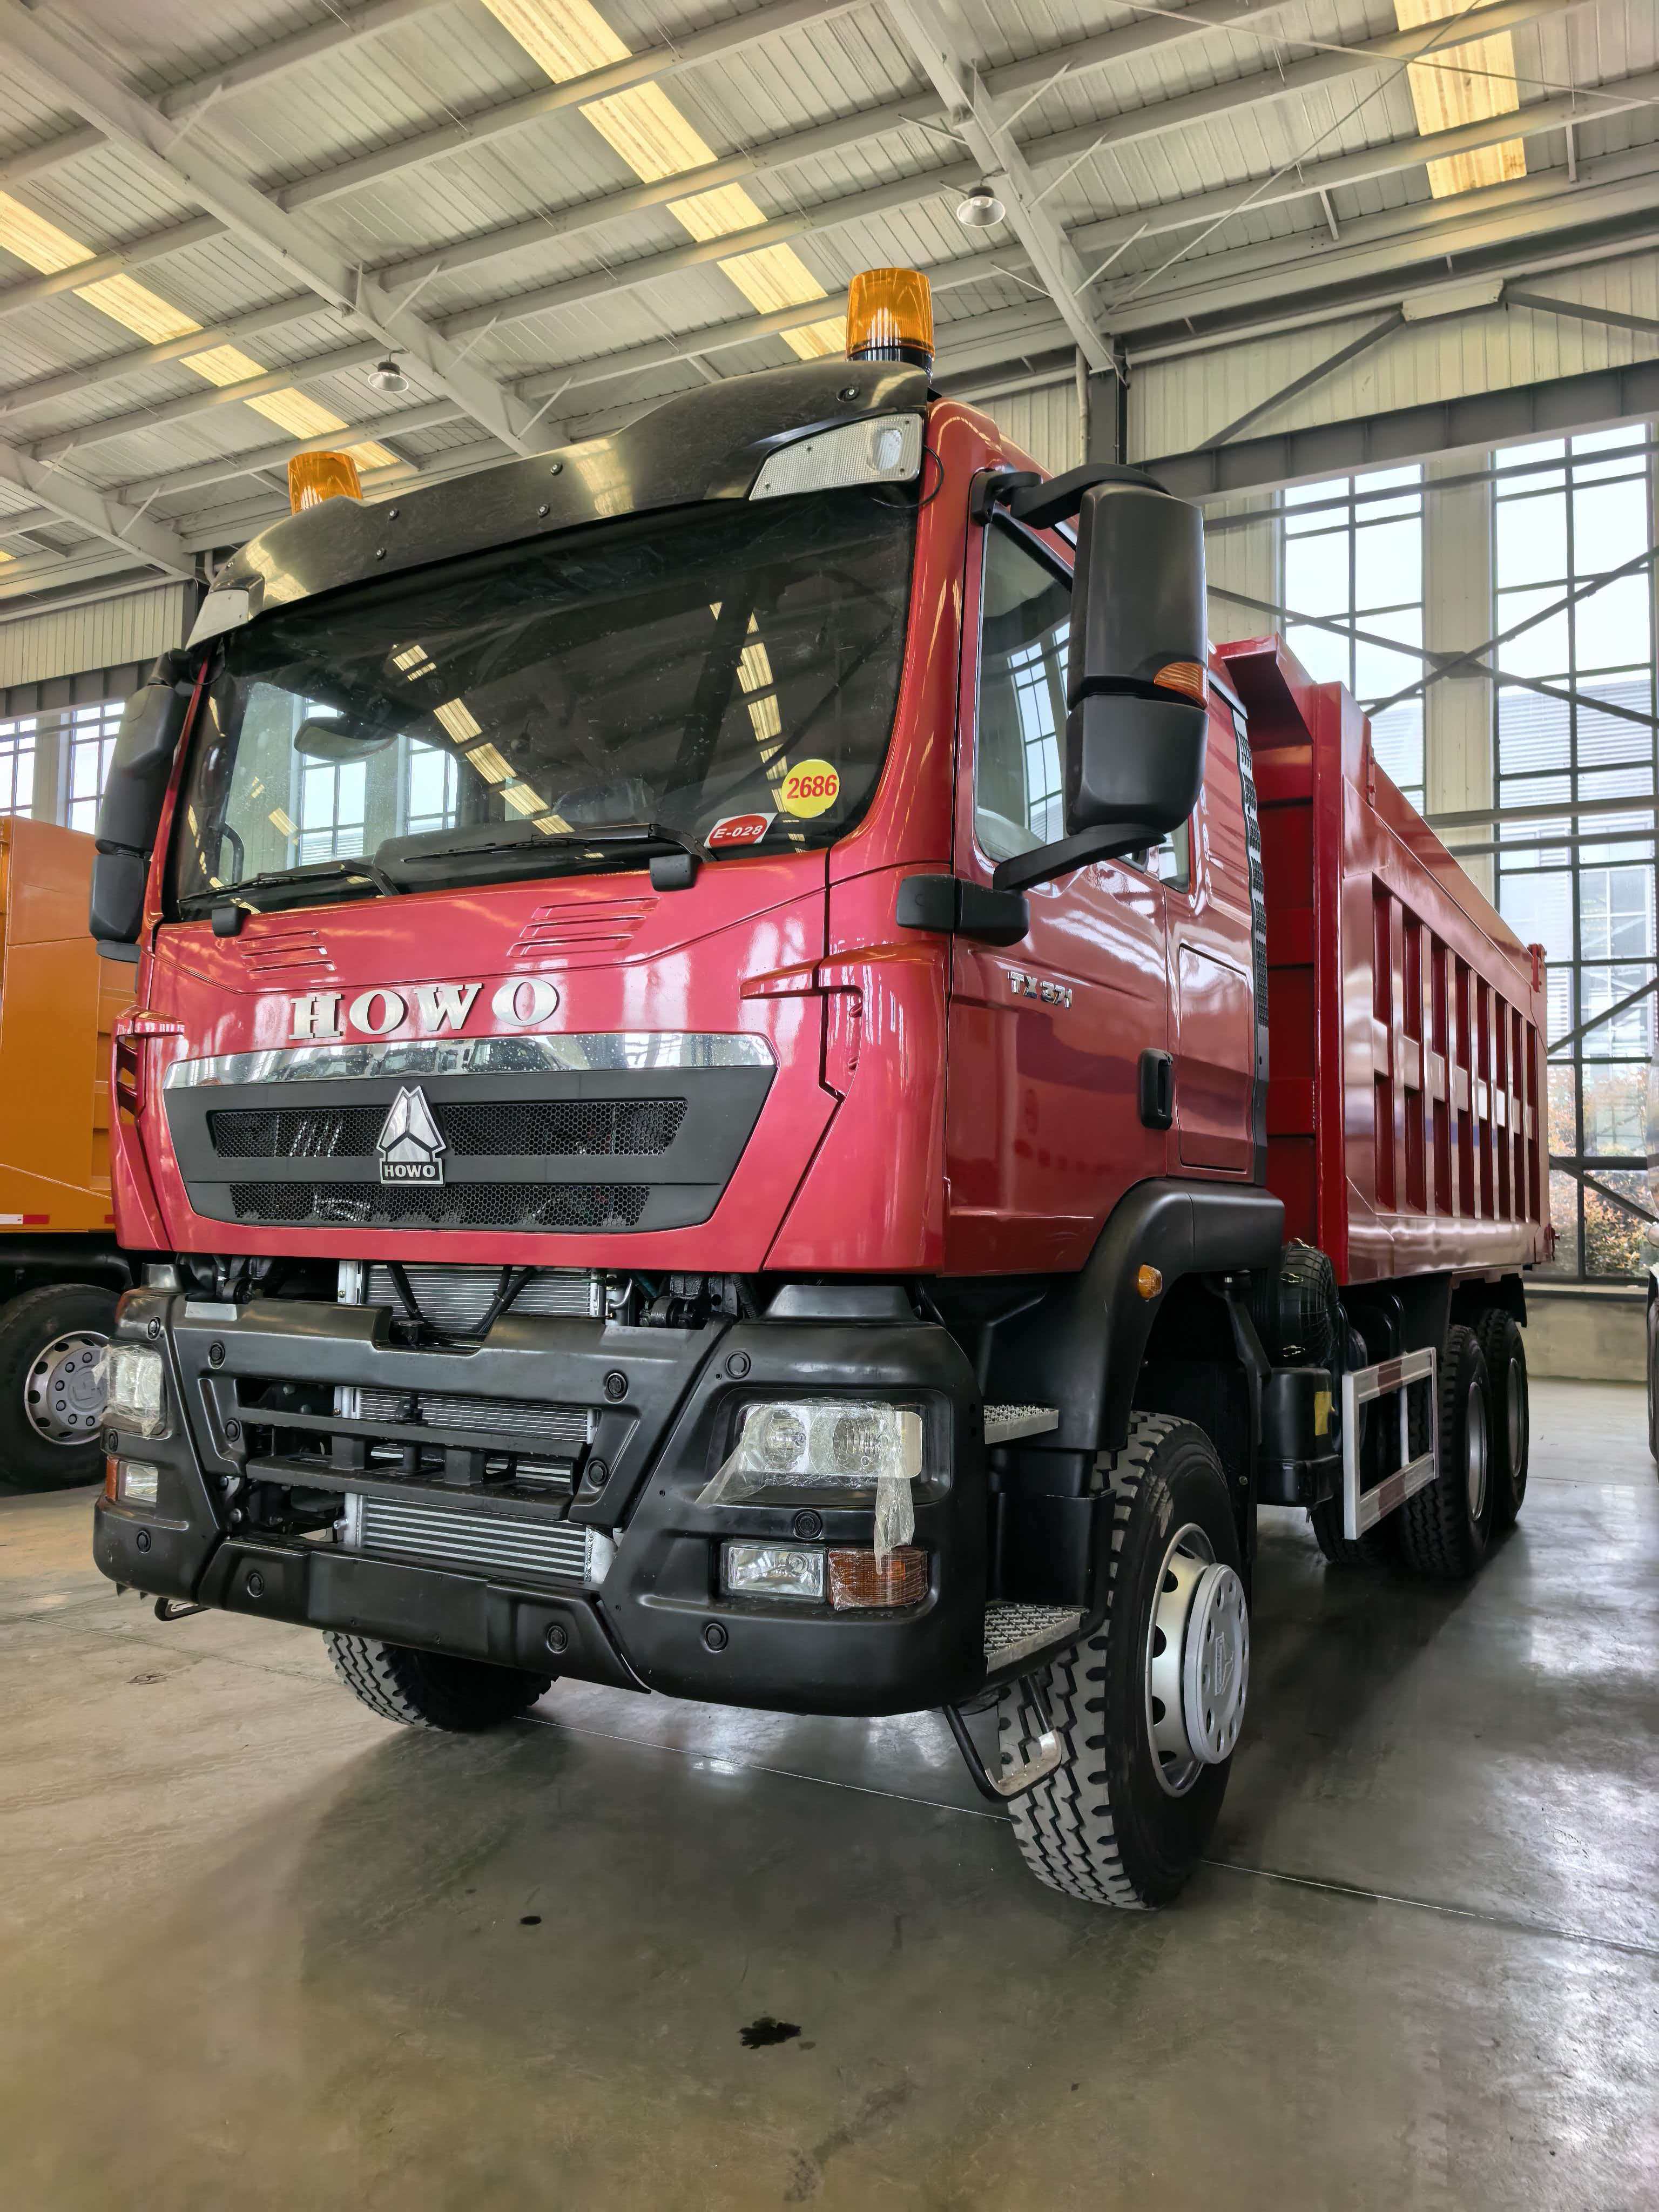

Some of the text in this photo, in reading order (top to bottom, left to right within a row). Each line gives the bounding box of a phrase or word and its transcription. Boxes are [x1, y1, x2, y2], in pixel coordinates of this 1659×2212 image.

[787, 774, 837, 799] 2686
[713, 825, 764, 839] E-028
[289, 977, 558, 1040] HOWO
[383, 1164, 436, 1178] HOWO
